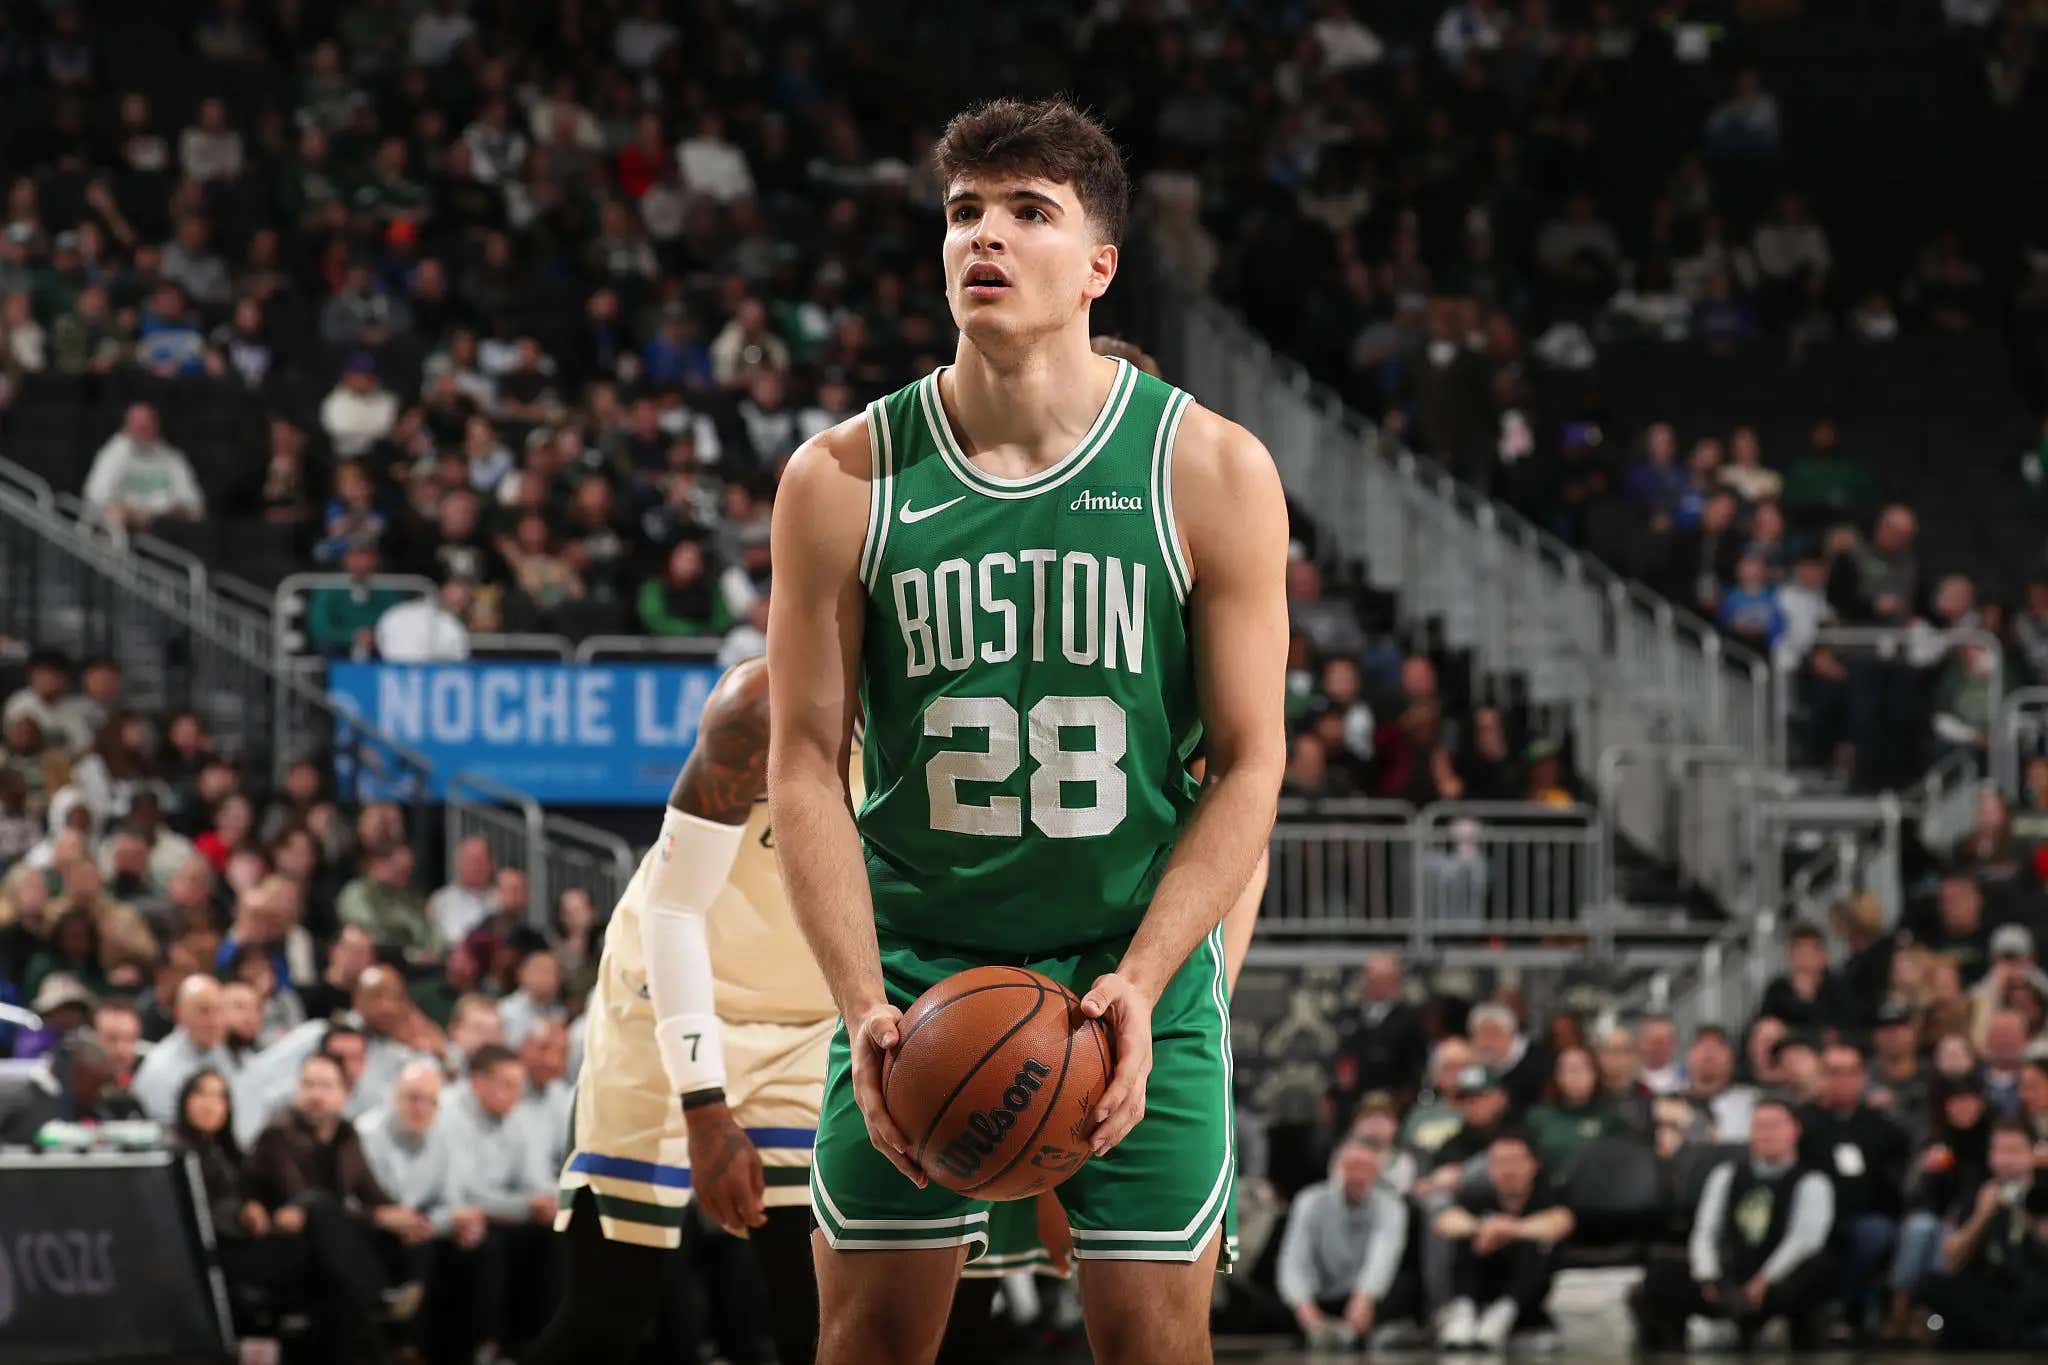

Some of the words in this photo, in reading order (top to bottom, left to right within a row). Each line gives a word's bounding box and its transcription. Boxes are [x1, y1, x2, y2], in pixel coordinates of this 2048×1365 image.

[1070, 489, 1143, 511] Amica
[892, 549, 1146, 678] BOSTON
[378, 669, 613, 745] NOCHE
[924, 696, 1127, 838] 28
[682, 1033, 702, 1062] 7
[936, 1058, 1052, 1176] Wilson
